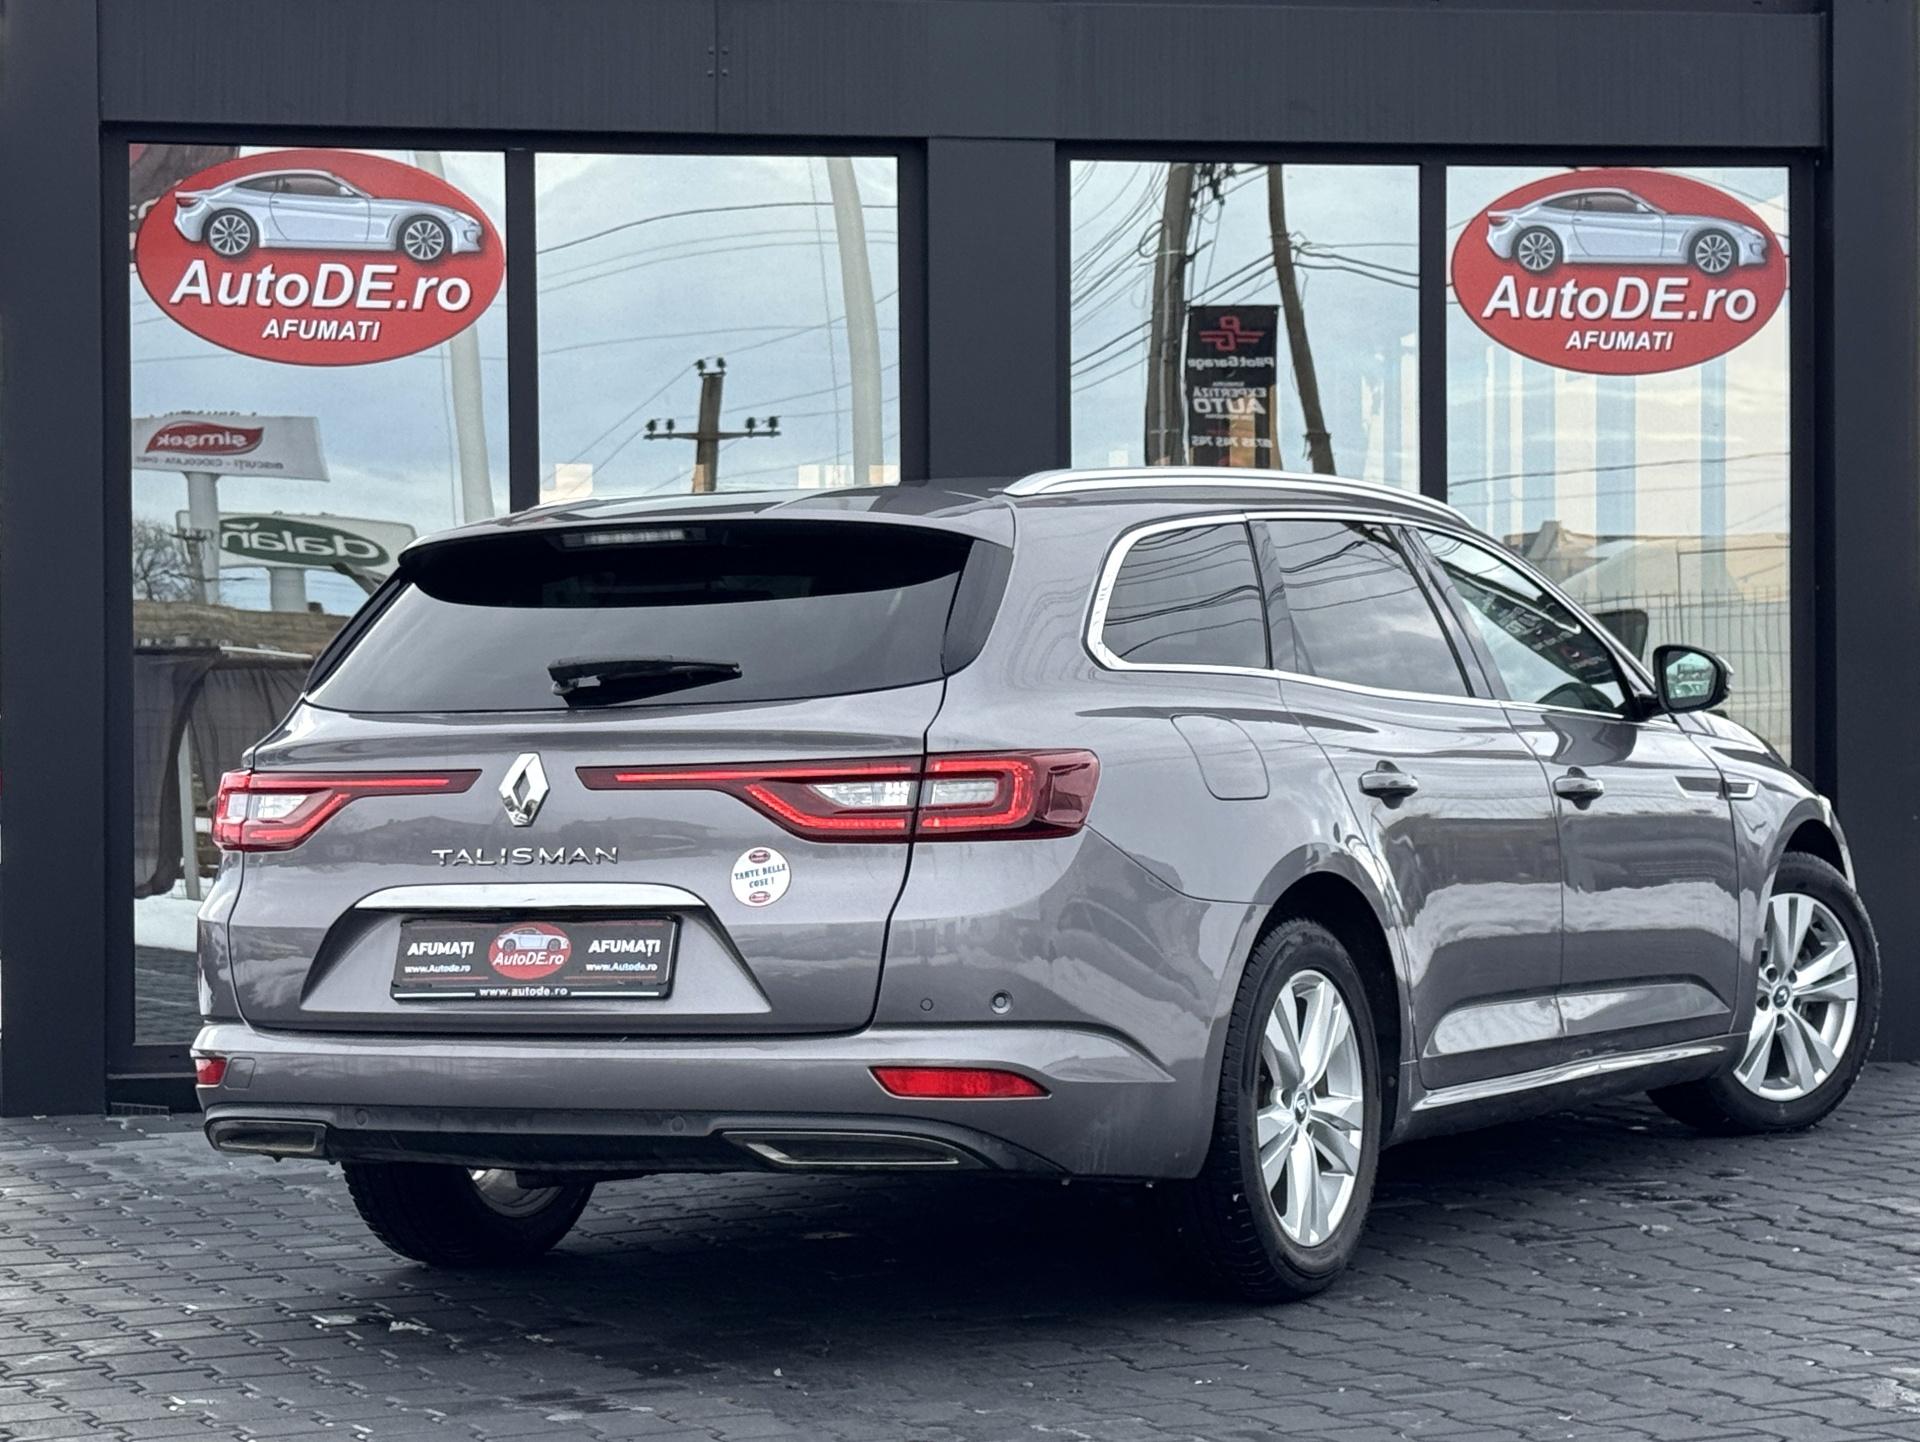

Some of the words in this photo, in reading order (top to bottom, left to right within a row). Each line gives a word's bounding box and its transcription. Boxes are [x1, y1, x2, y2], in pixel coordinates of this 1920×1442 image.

[169, 258, 472, 312] AutoDE.ro
[1481, 274, 1758, 322] AutoDE.ro
[261, 318, 382, 342] AFUMATI
[1565, 331, 1674, 351] AFUMATI
[431, 847, 619, 867] TALISMAN
[734, 868, 760, 880] TANTE
[762, 863, 787, 875] BELLE
[492, 951, 565, 966] AutoDE.ro
[479, 985, 568, 996] www.autode.ro
